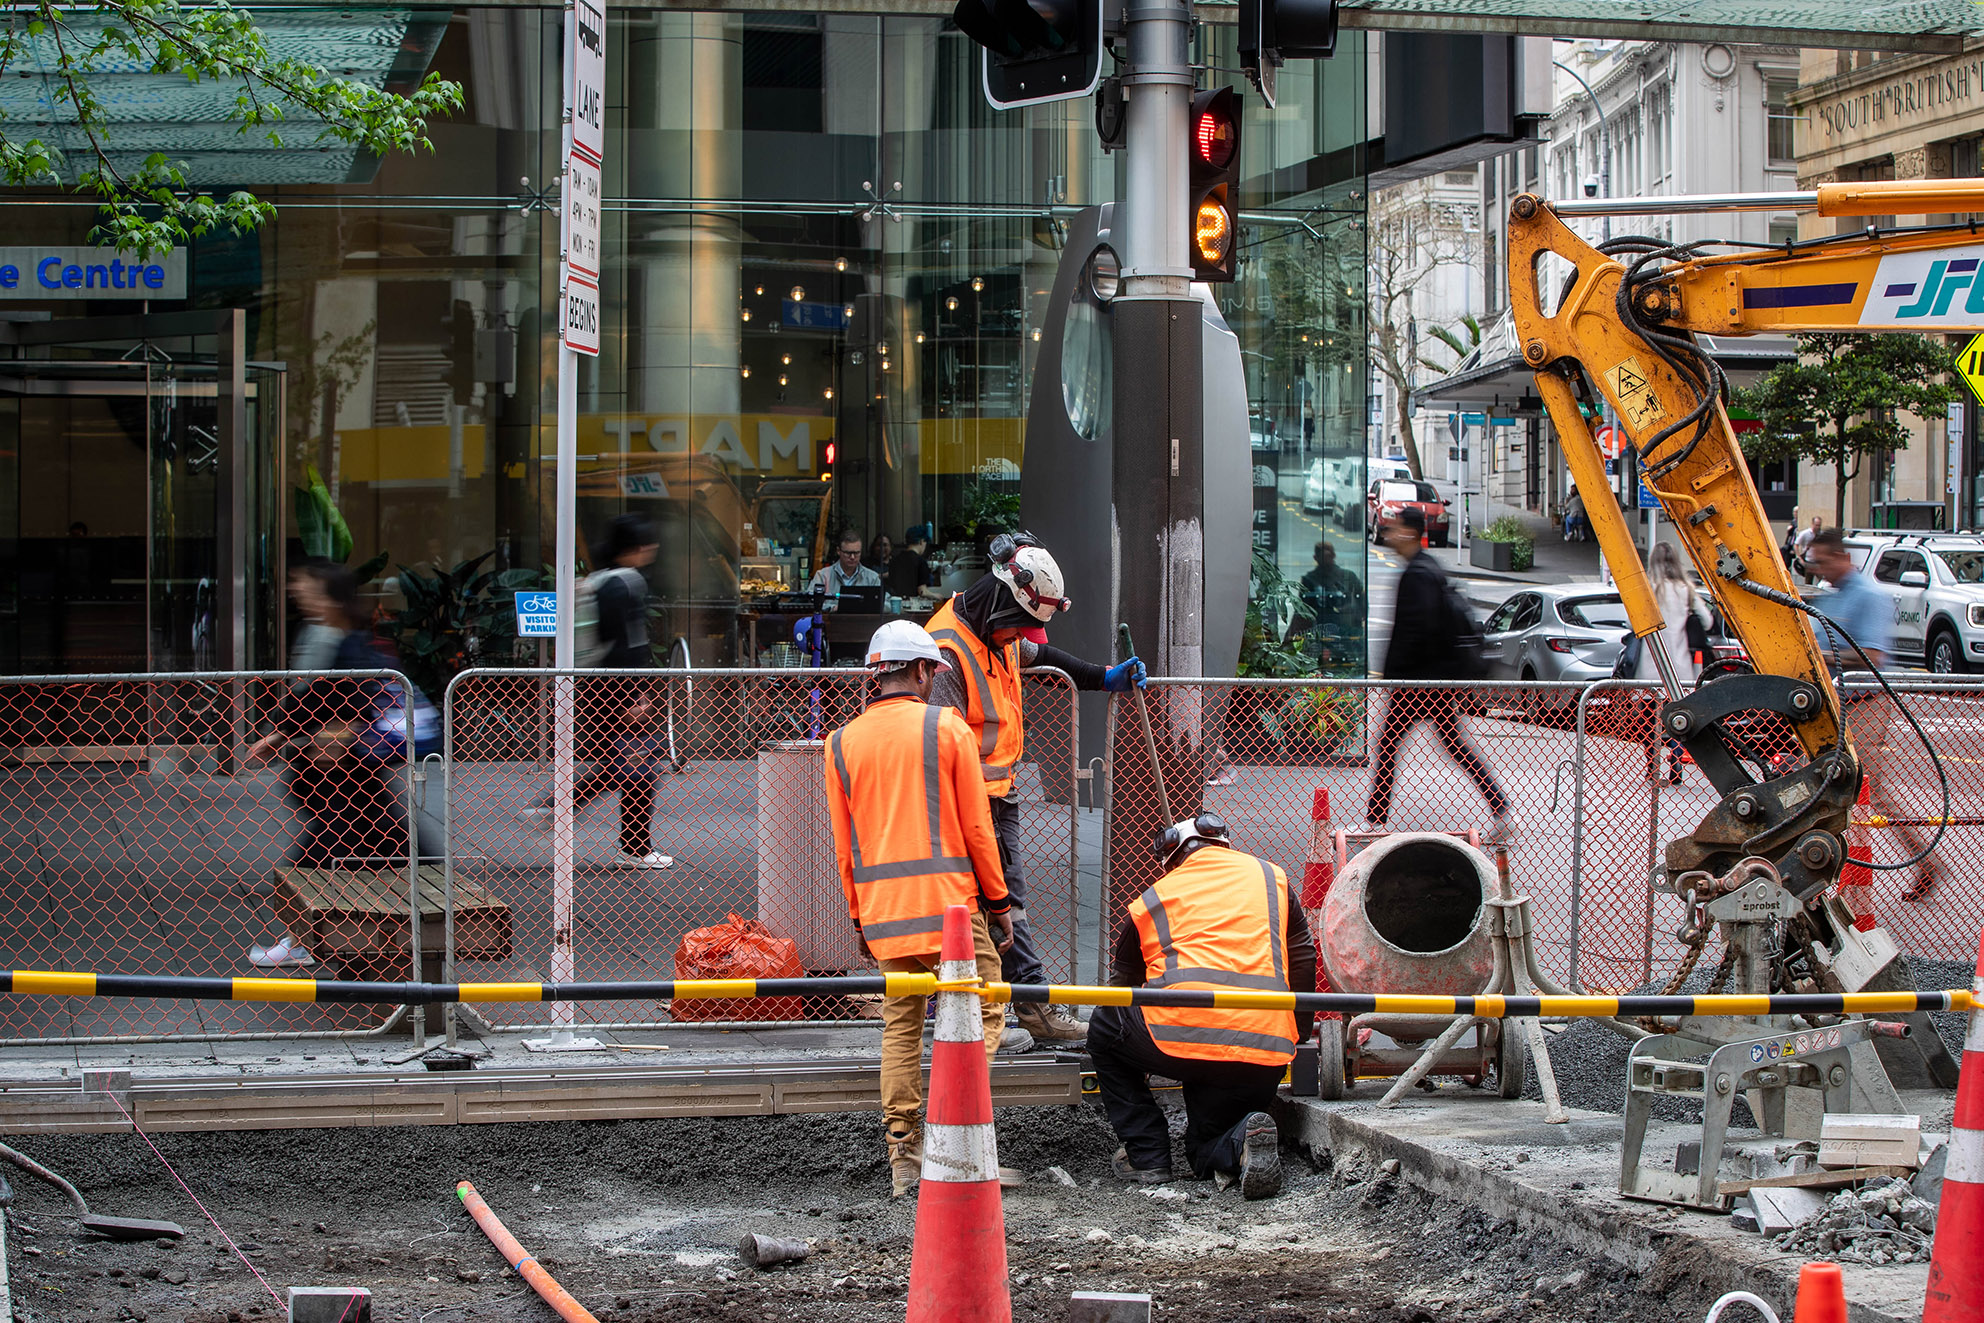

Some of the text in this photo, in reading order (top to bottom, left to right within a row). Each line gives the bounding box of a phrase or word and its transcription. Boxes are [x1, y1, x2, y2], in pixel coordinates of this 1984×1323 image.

[578, 79, 600, 130] LANE
[1825, 90, 1884, 136] SOUTH
[1893, 65, 1969, 116] BRITISH
[572, 168, 582, 192] 7AM
[572, 200, 582, 223] 4PM
[588, 207, 598, 230] 7PM
[572, 231, 583, 255] MON
[588, 239, 596, 261] FRI
[36, 256, 166, 289] Centre
[569, 295, 597, 335] BEGINS
[985, 457, 1002, 466] THE
[525, 615, 556, 624] VISITO
[525, 624, 557, 633] PARKIN
[1749, 900, 1781, 912] probst
